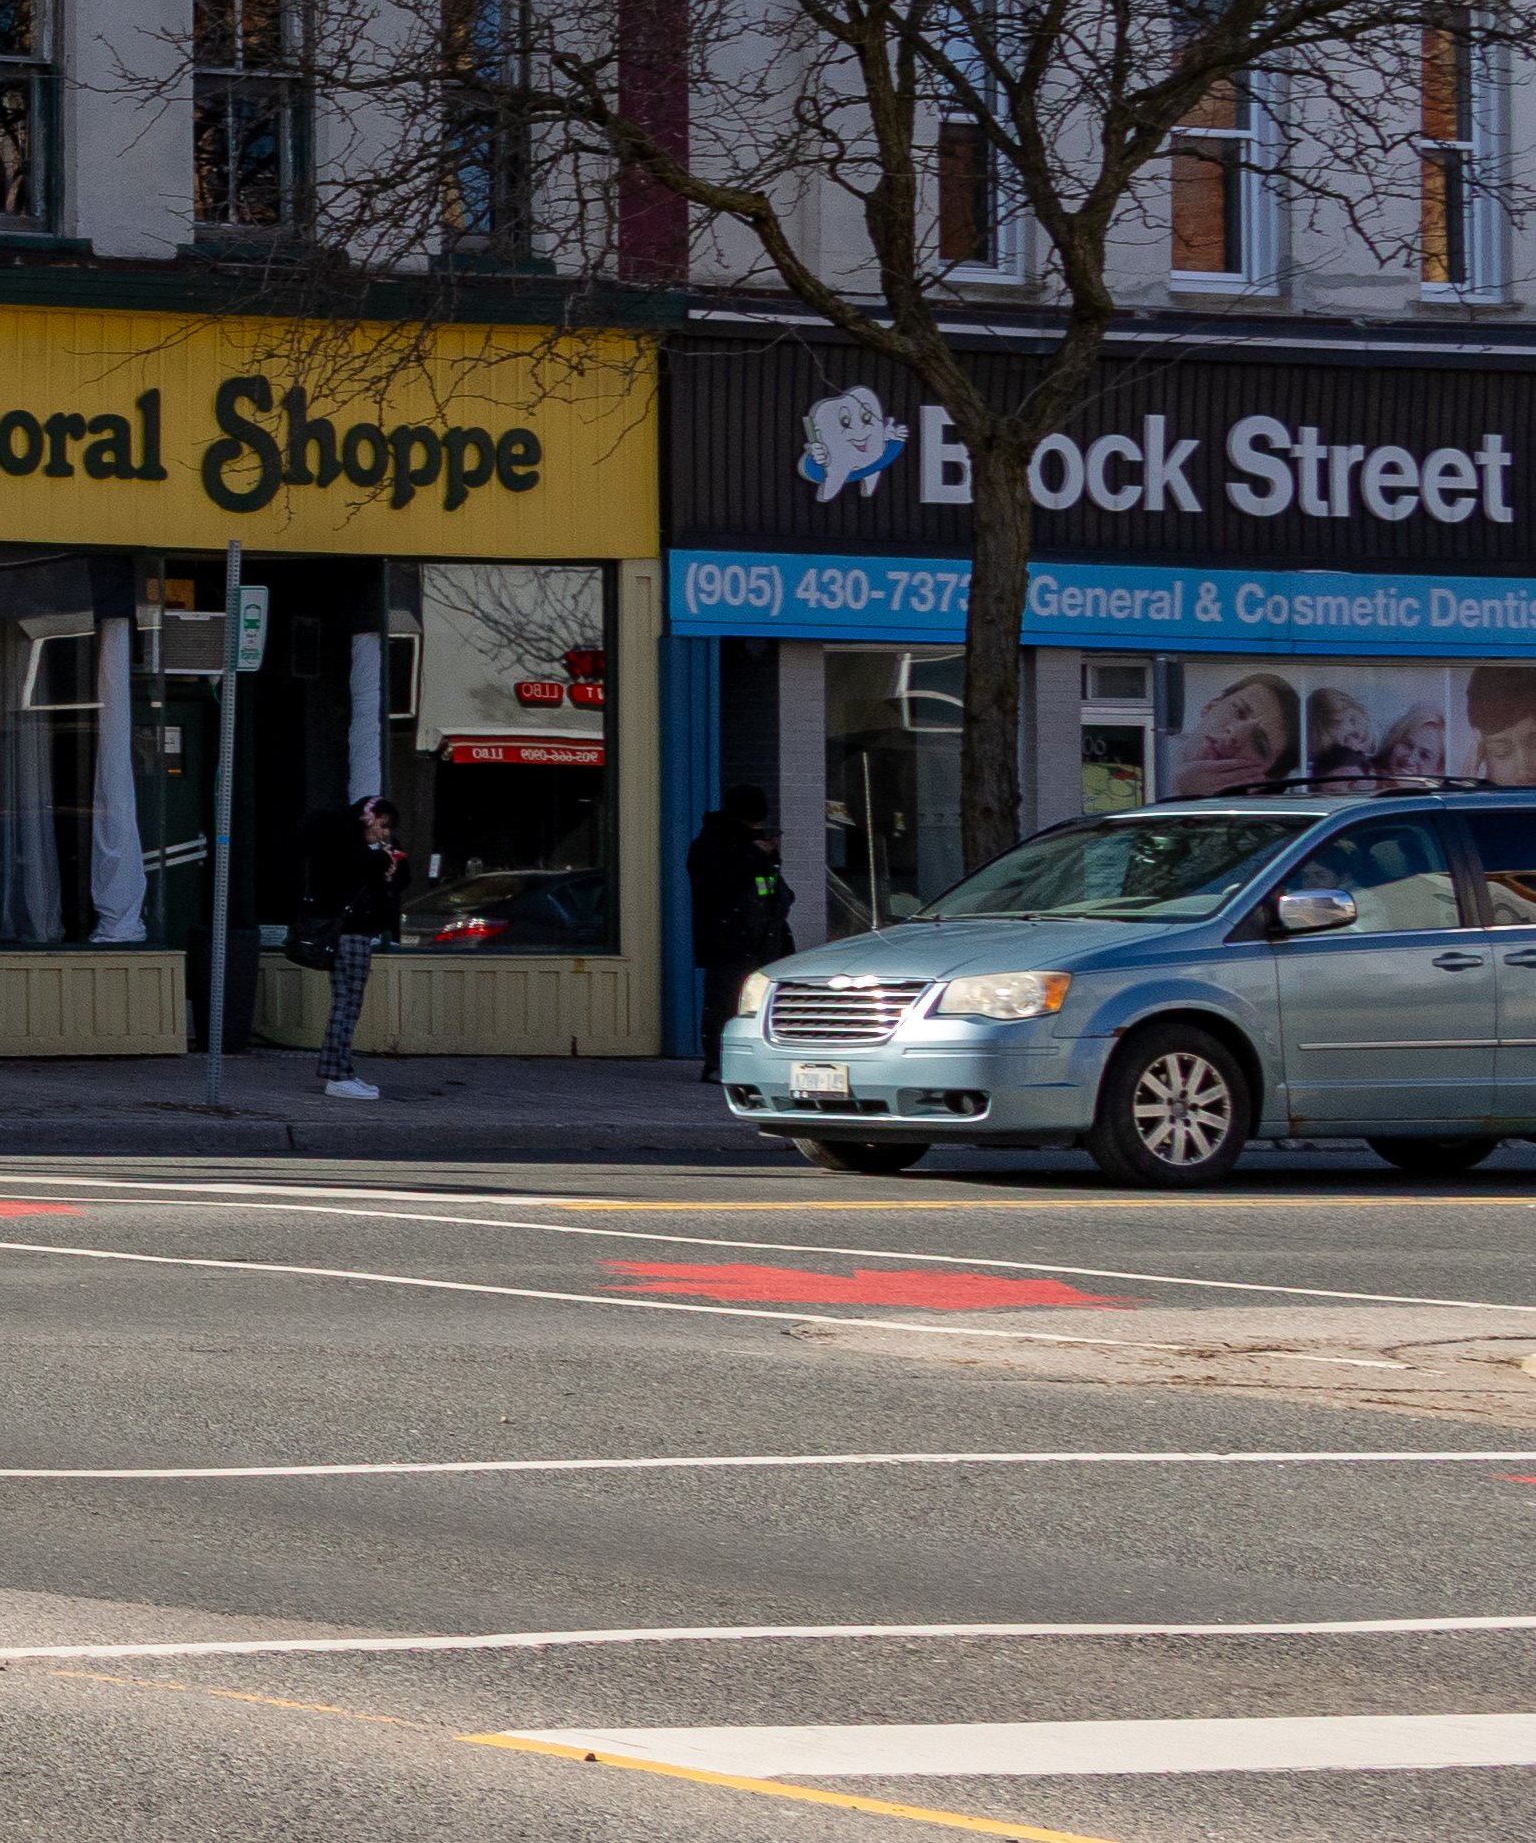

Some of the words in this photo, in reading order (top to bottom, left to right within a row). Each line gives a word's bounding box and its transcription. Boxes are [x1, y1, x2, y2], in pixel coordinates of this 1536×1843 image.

[202, 374, 542, 514] Shoppe
[919, 405, 1204, 512] Bock
[1226, 414, 1513, 523] Street
[685, 562, 783, 617] (905)
[1030, 574, 1183, 621] General
[1194, 581, 1223, 623] &
[1235, 582, 1421, 627] Cosmetic
